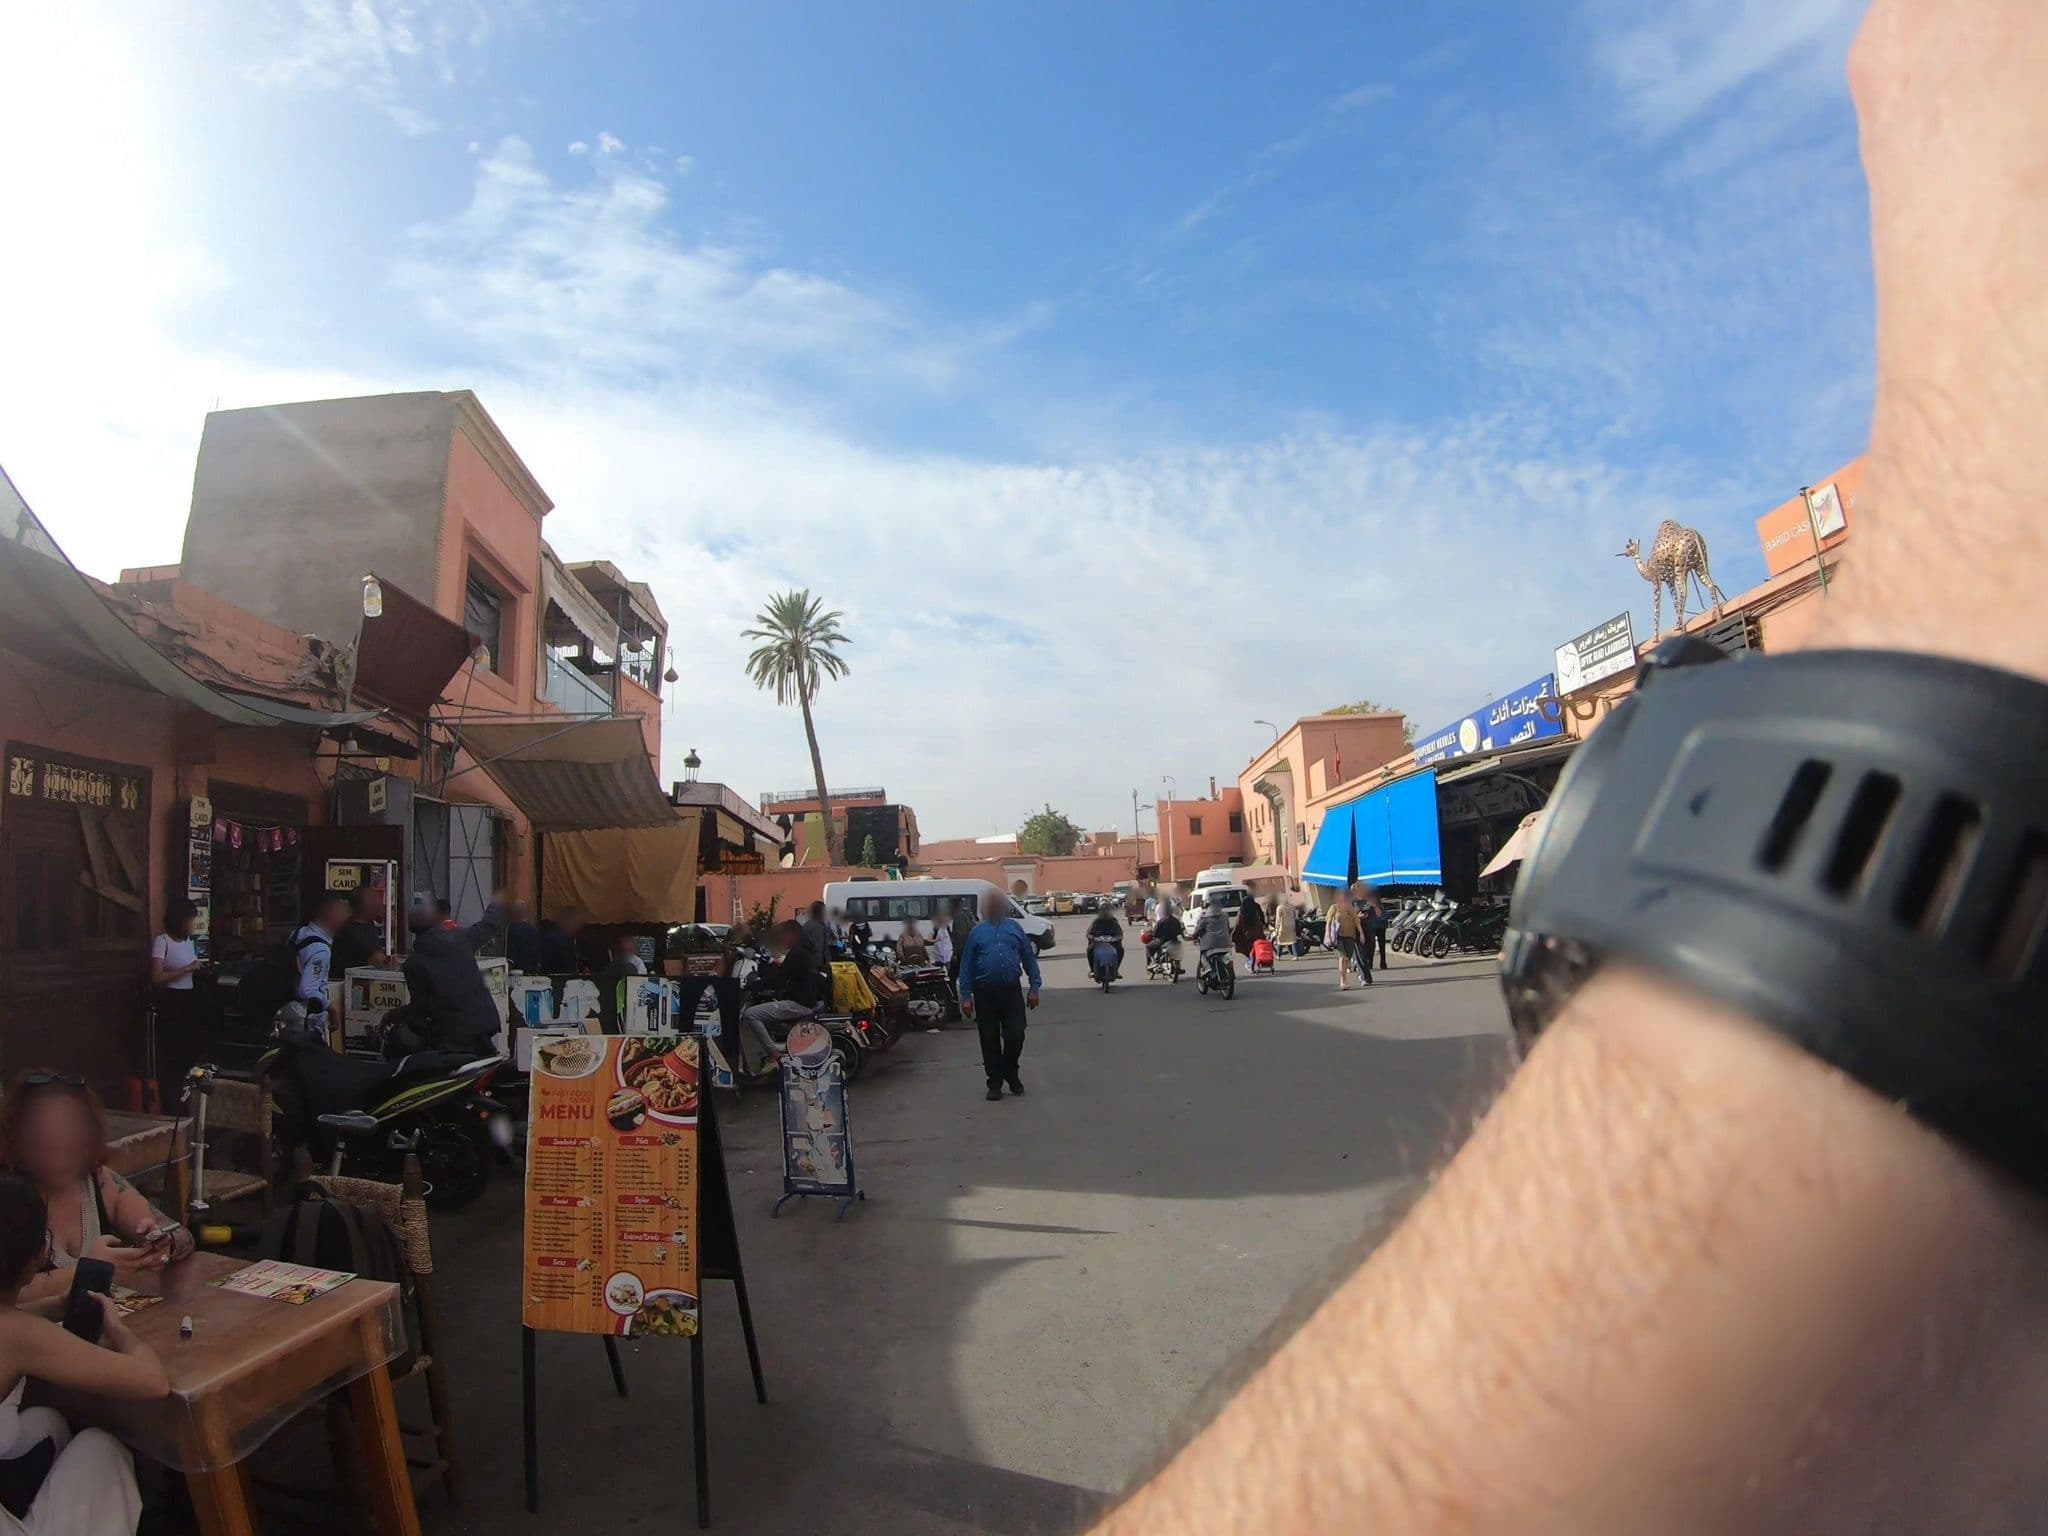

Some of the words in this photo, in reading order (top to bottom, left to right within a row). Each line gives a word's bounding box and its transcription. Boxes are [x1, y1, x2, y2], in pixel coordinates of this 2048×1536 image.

[338, 868, 353, 876] SIM
[333, 879, 357, 888] CARD
[379, 983, 396, 993] SIM
[374, 996, 402, 1007] CARD
[540, 1104, 594, 1120] MENU
